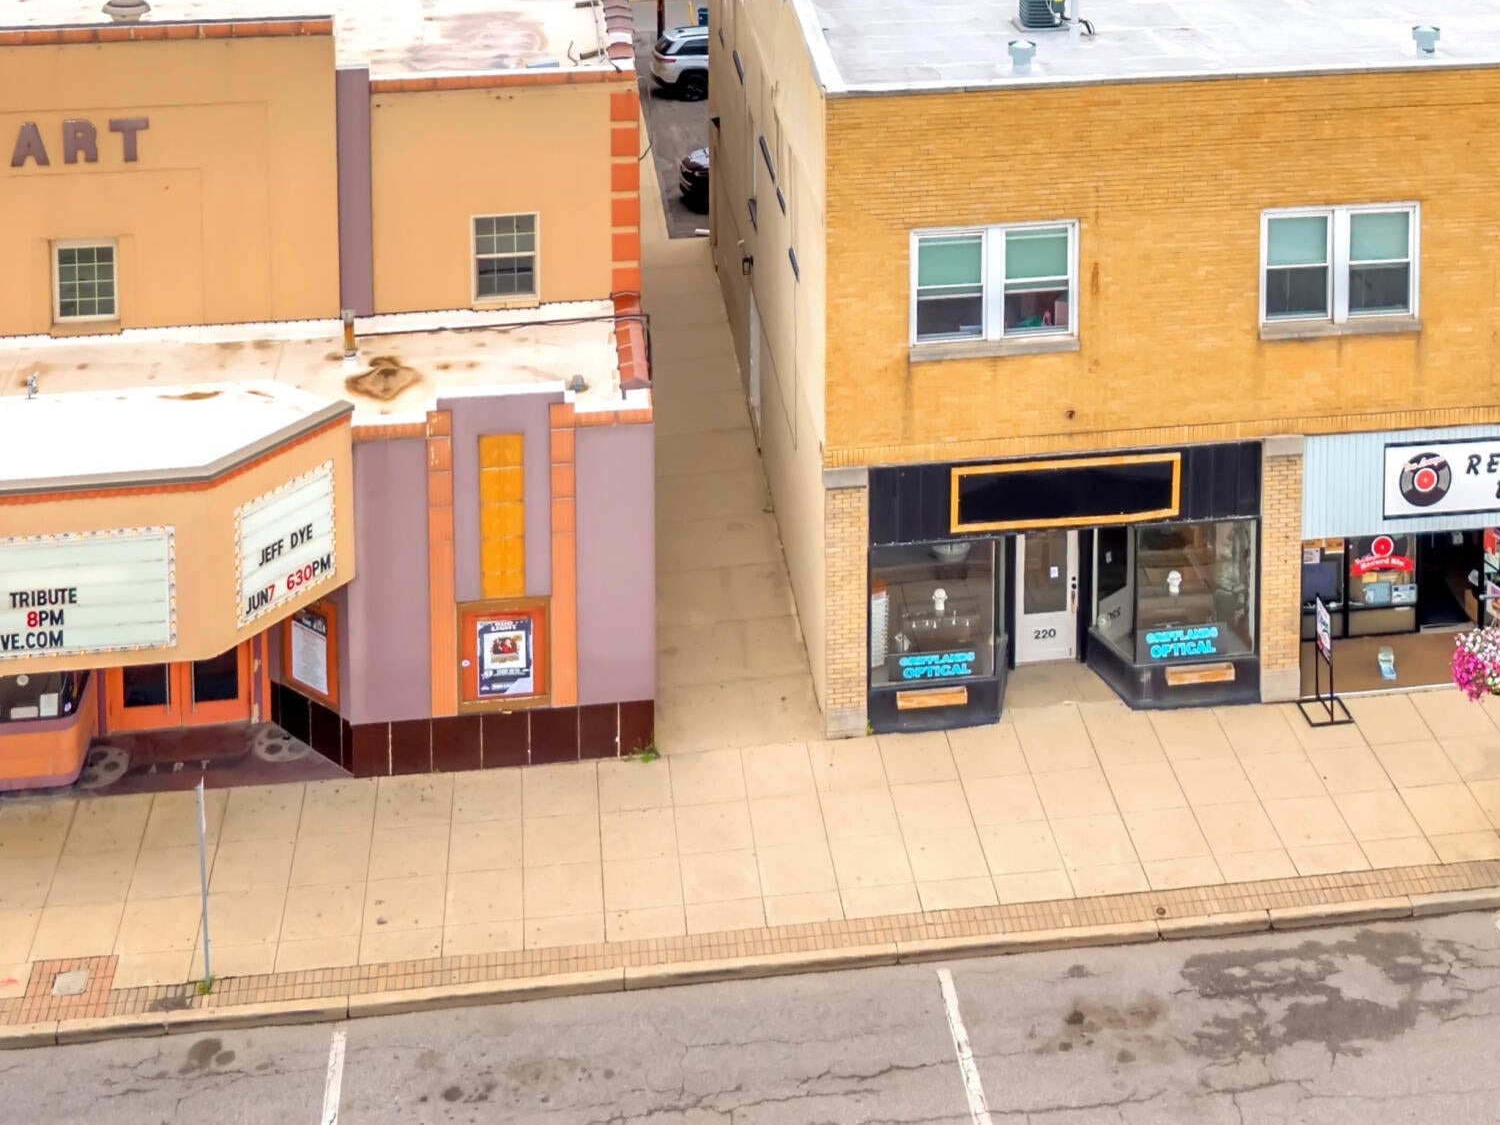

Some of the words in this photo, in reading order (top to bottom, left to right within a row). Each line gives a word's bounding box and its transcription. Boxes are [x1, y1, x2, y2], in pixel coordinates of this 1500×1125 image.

[11, 118, 149, 167] ART
[258, 538, 284, 567] JEFF
[290, 523, 313, 549] DYE
[286, 553, 331, 591] 630PM
[9, 587, 78, 609] TRIBUTE
[27, 609, 65, 628] 8PM
[0, 630, 64, 651] VE.COM
[1034, 628, 1057, 639] 220
[1151, 640, 1216, 658] OPTICAL
[903, 663, 971, 679] OPTICAL
[149, 759, 211, 774] ART
